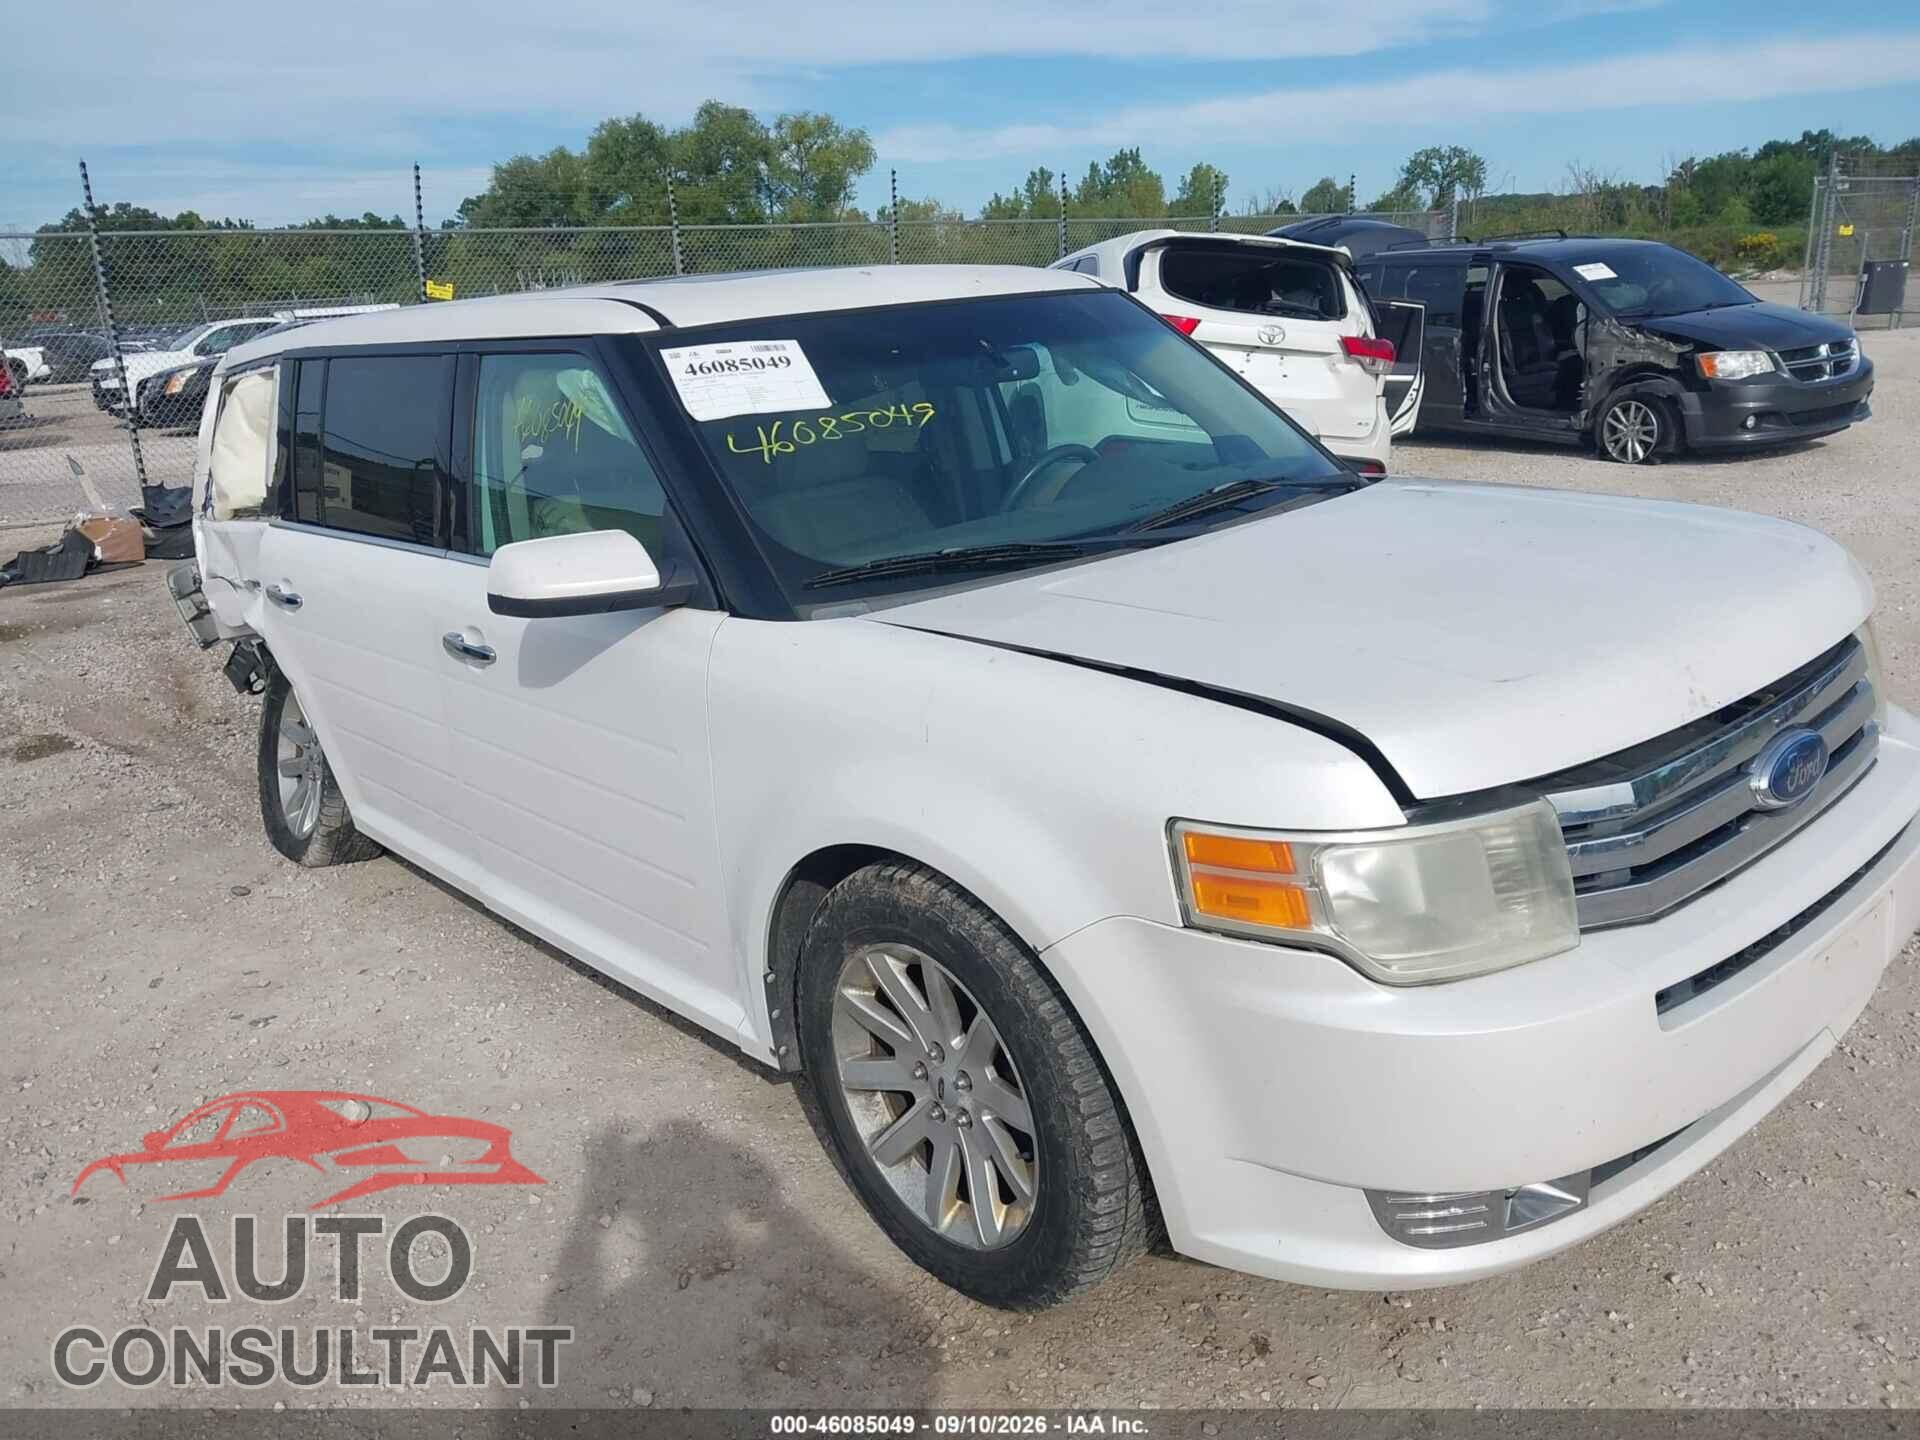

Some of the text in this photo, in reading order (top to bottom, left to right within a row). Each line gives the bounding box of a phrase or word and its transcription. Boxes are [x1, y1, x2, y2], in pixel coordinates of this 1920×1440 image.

[684, 355, 792, 377] 46085049
[726, 402, 936, 464] 46085049
[1786, 747, 1822, 793] Ford
